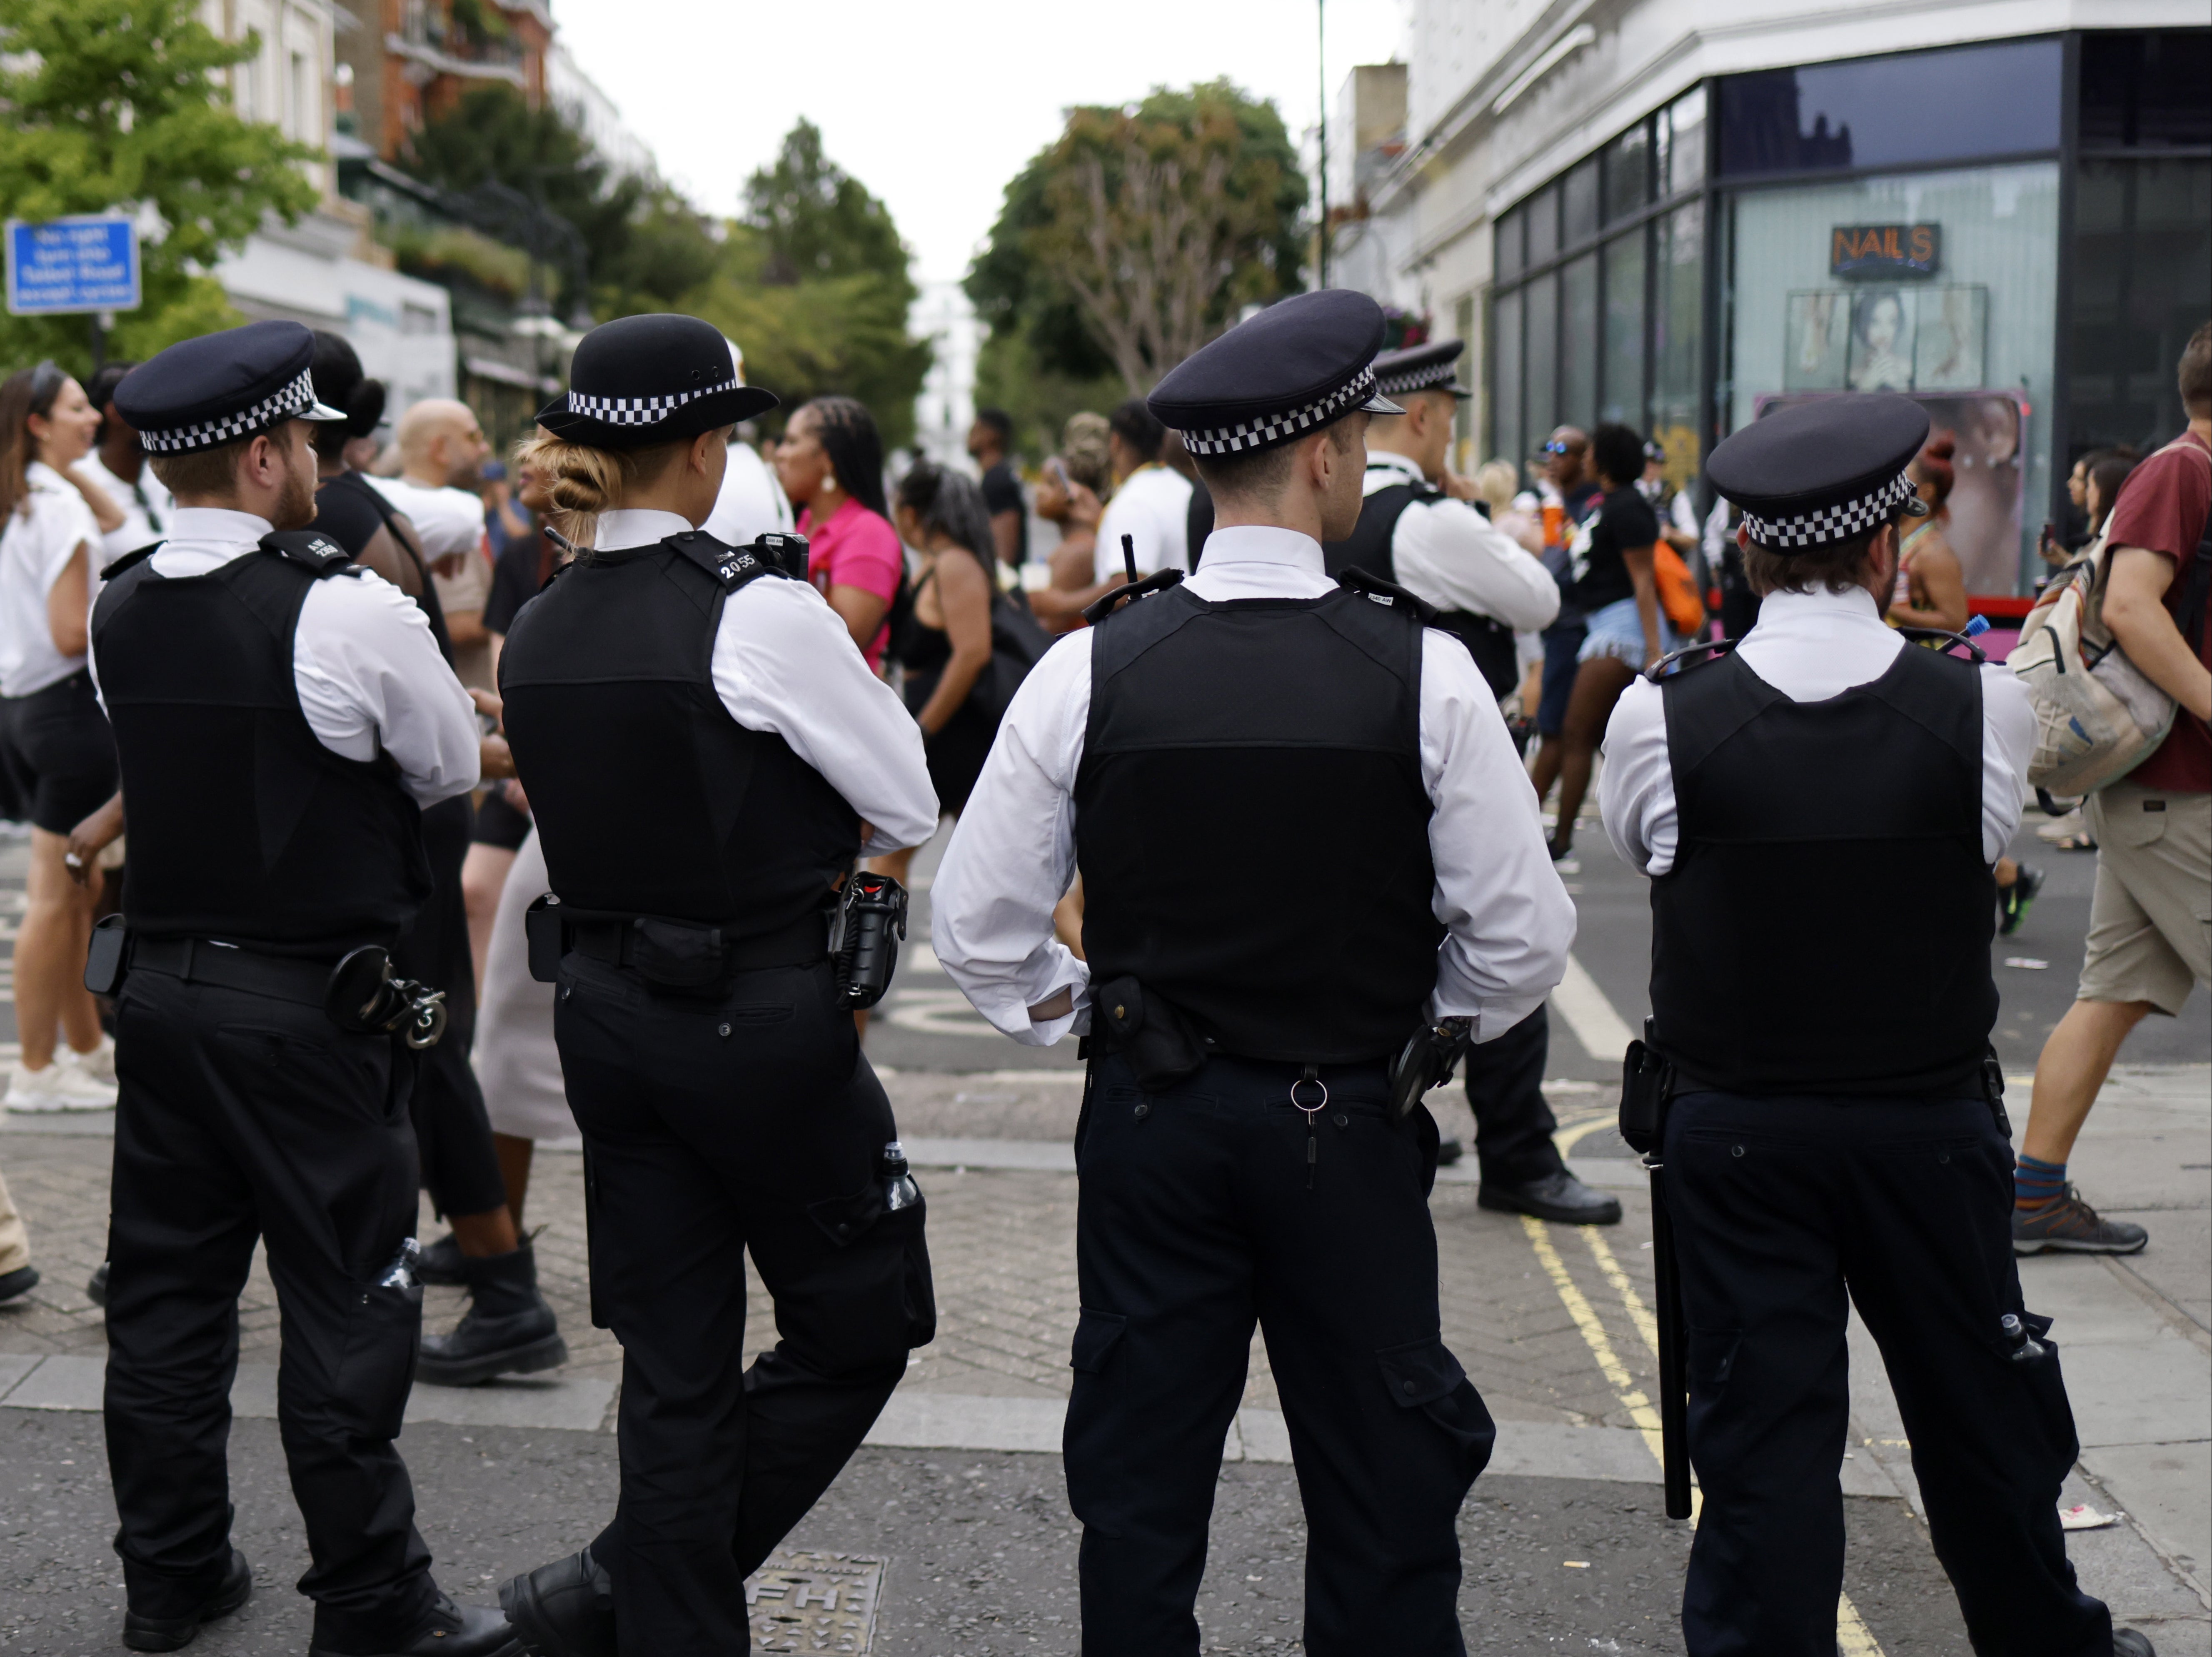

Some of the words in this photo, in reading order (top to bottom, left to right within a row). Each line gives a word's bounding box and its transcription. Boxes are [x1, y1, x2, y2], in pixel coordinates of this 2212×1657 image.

[1834, 227, 1932, 265] NAILS
[307, 539, 326, 551] AW
[721, 554, 755, 579] 2055
